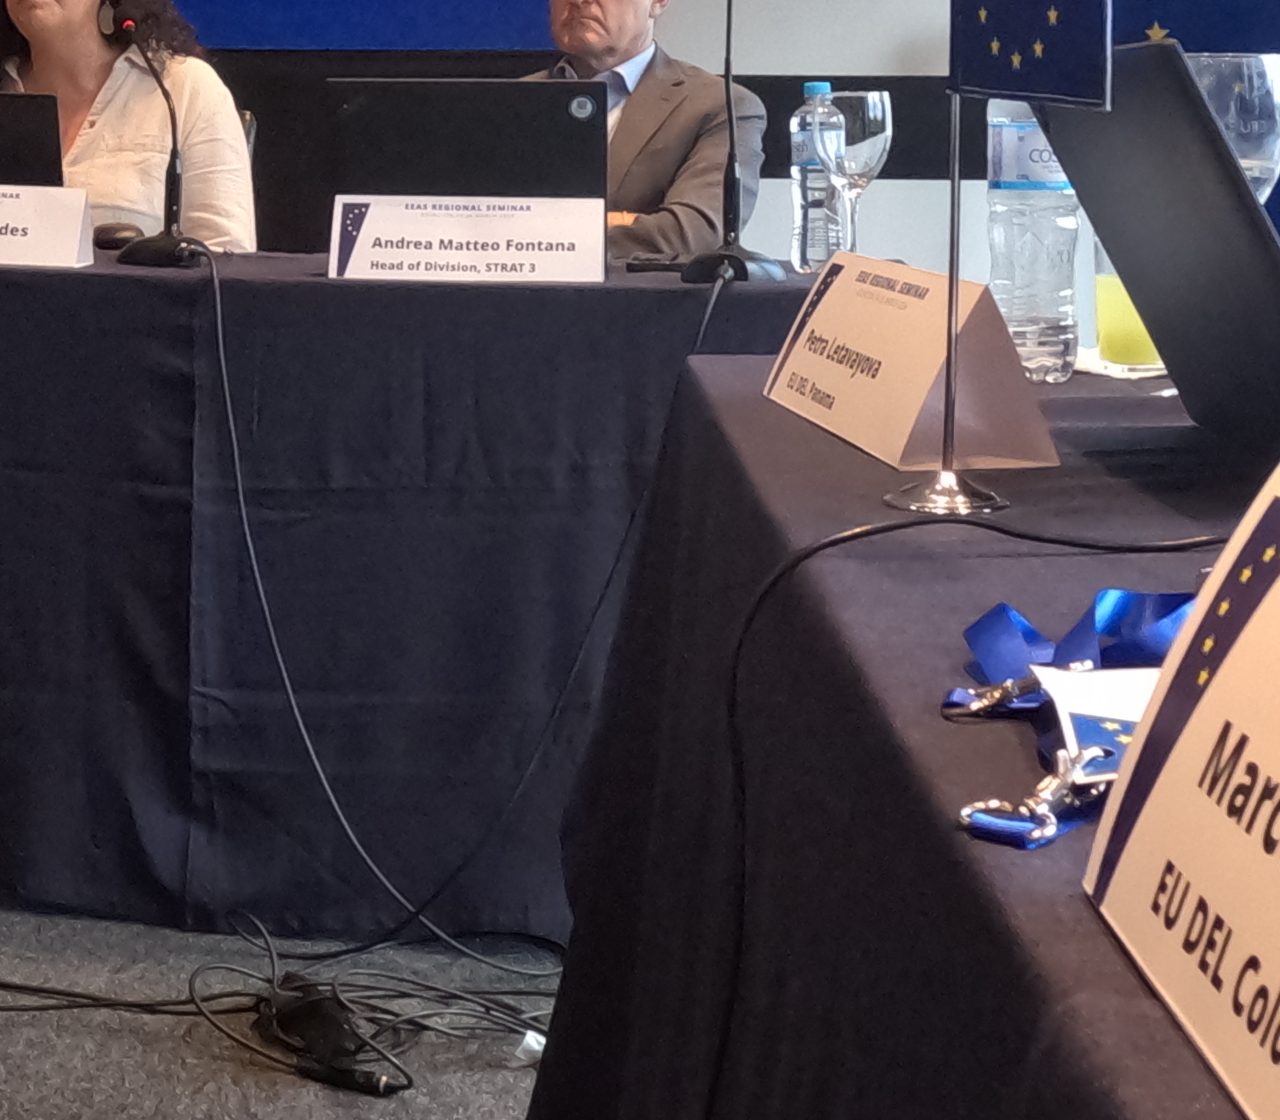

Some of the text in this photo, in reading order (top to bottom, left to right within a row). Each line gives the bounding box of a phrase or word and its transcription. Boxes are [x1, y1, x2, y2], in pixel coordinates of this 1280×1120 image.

[404, 203, 532, 213] EEAS REGIONAL SEMINAR
[371, 237, 576, 253] Andrea Matteo Fontana
[370, 260, 536, 274] Head of Division, STRAT 3
[803, 328, 829, 356] Petra
[1151, 859, 1192, 931] EU
[1182, 895, 1234, 993] DEL
